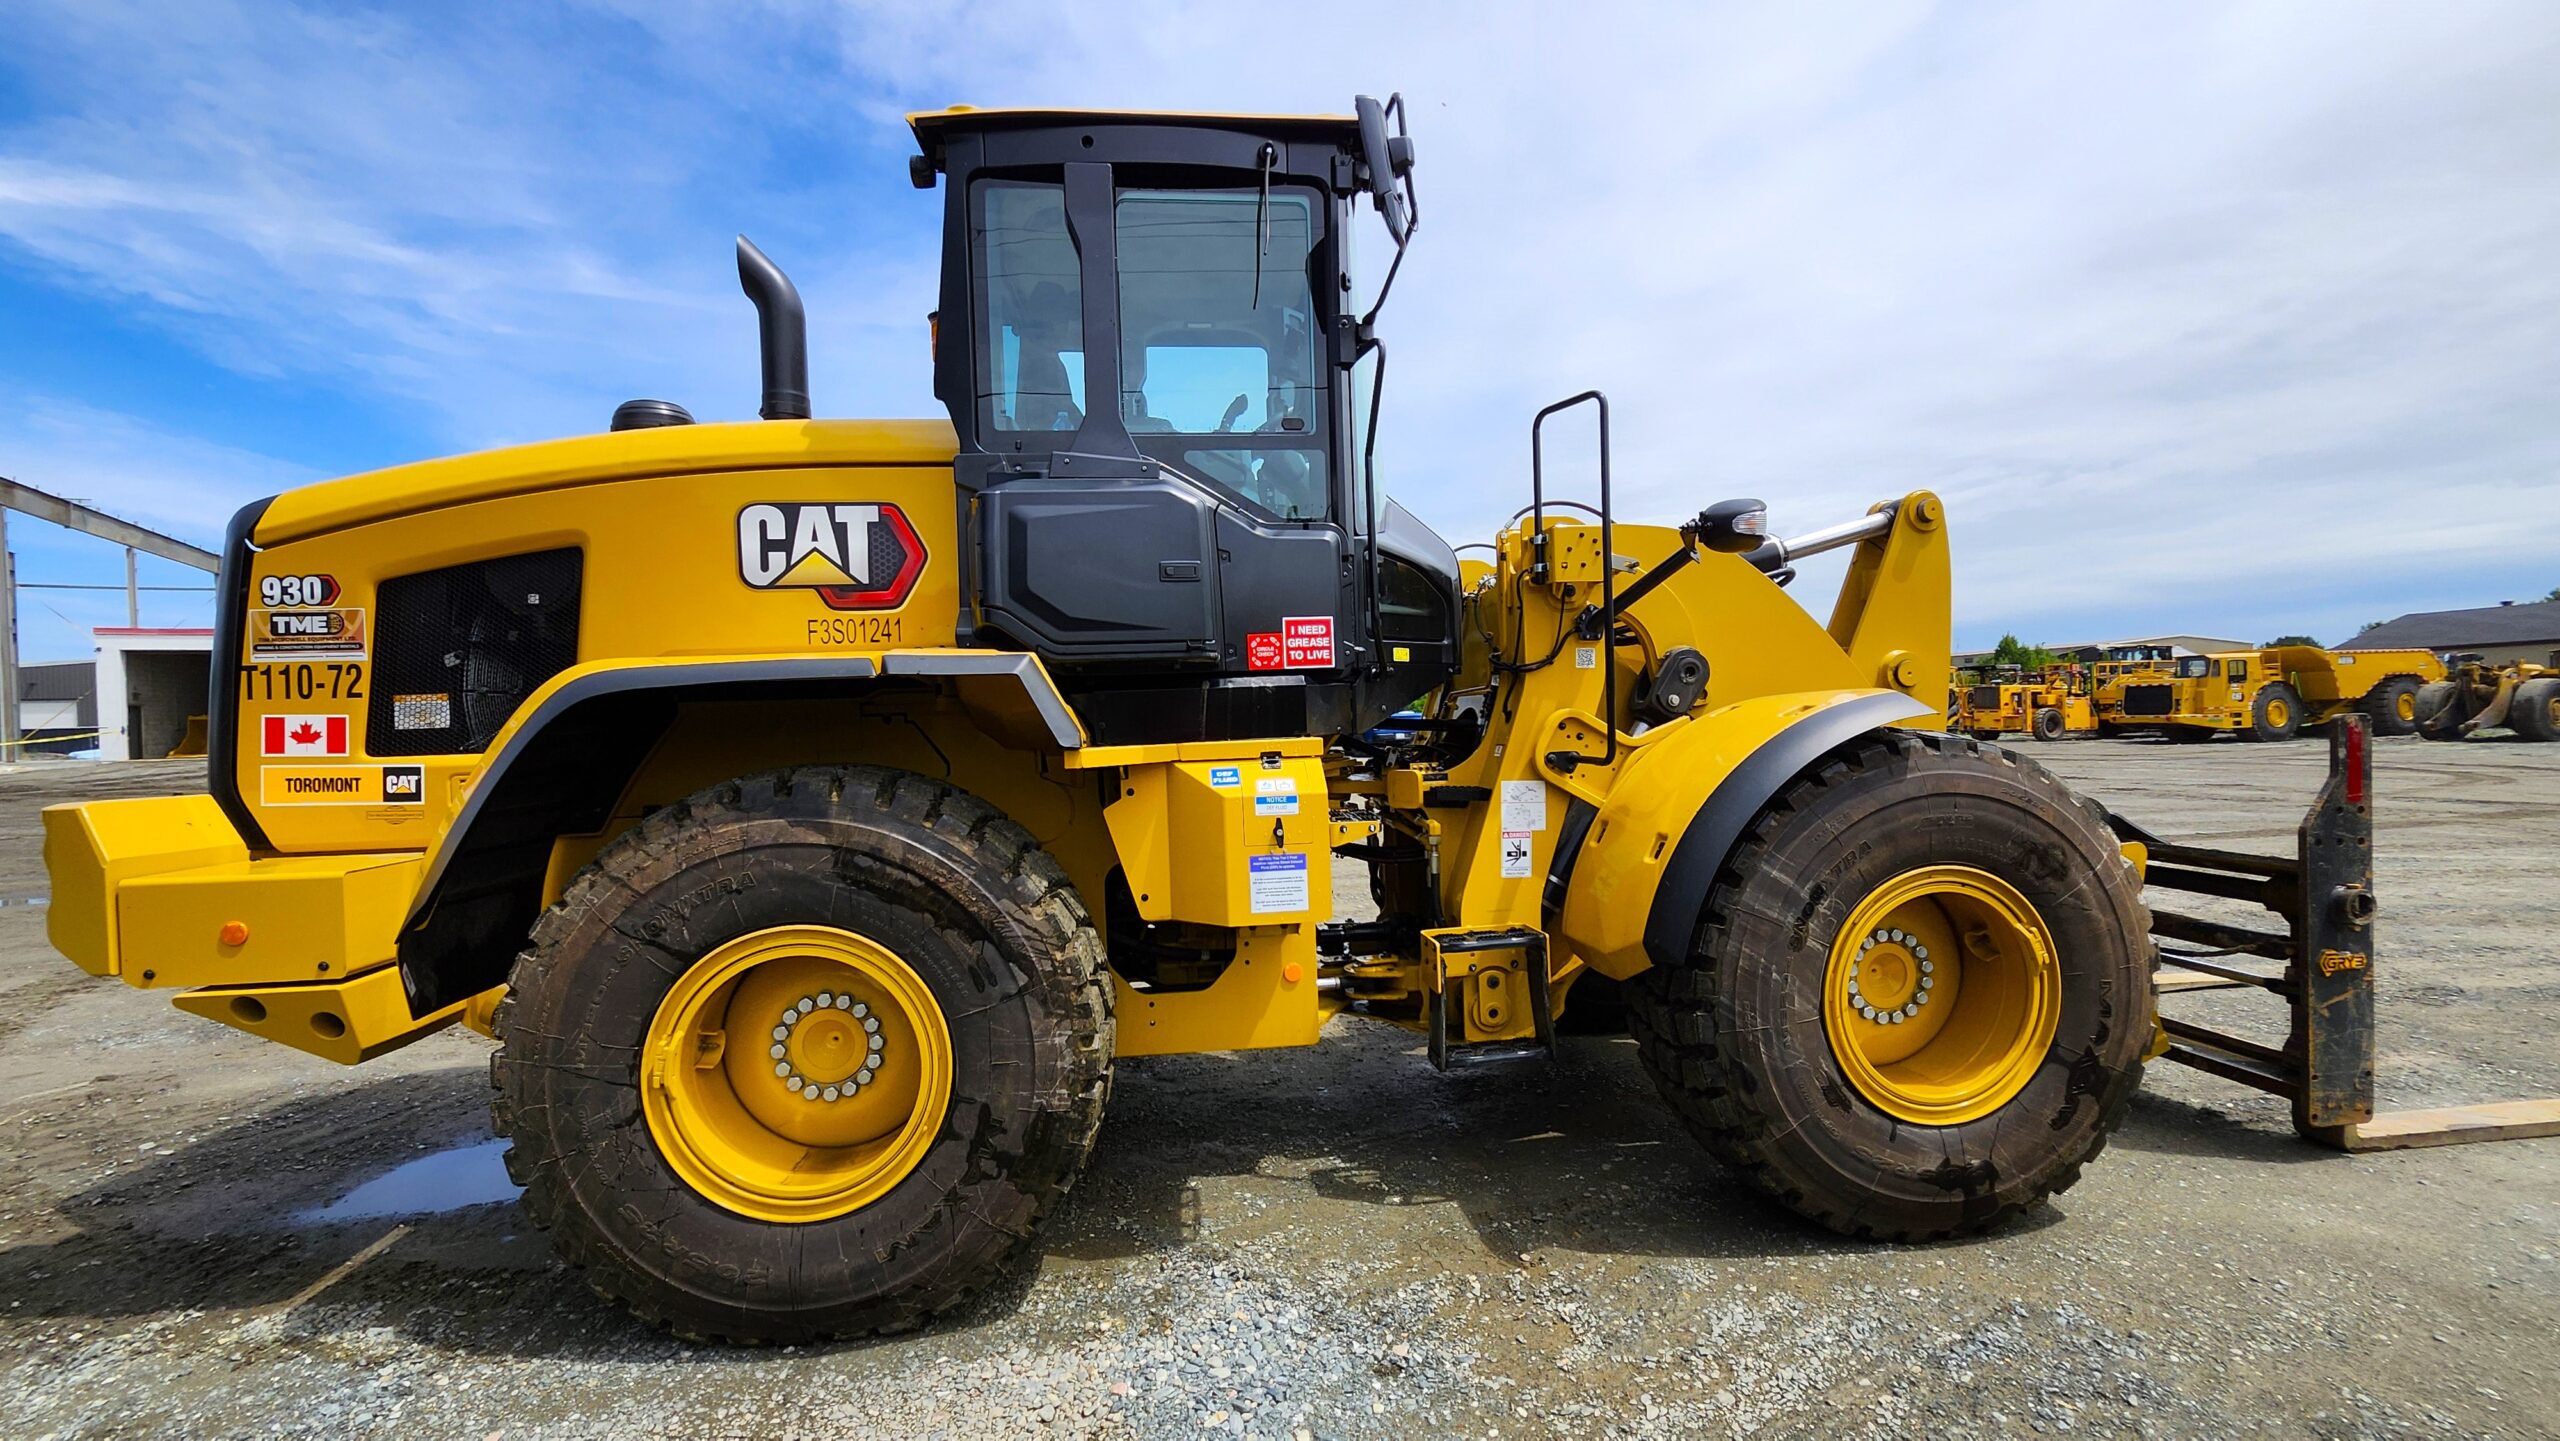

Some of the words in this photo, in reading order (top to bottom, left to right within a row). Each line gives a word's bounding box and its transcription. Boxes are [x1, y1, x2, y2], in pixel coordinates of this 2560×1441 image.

[739, 504, 880, 586] CAT
[261, 575, 322, 606] 930
[272, 615, 328, 634] TME
[807, 617, 902, 645] F3S01241
[1290, 625, 1295, 635] I
[1297, 625, 1326, 635] NEED
[1288, 637, 1330, 648] GREASE
[1289, 650, 1304, 660] TO
[1307, 650, 1330, 660] LIVE
[241, 663, 363, 700] T110-72
[285, 777, 362, 793] TOROMONT
[386, 775, 420, 794] CAT
